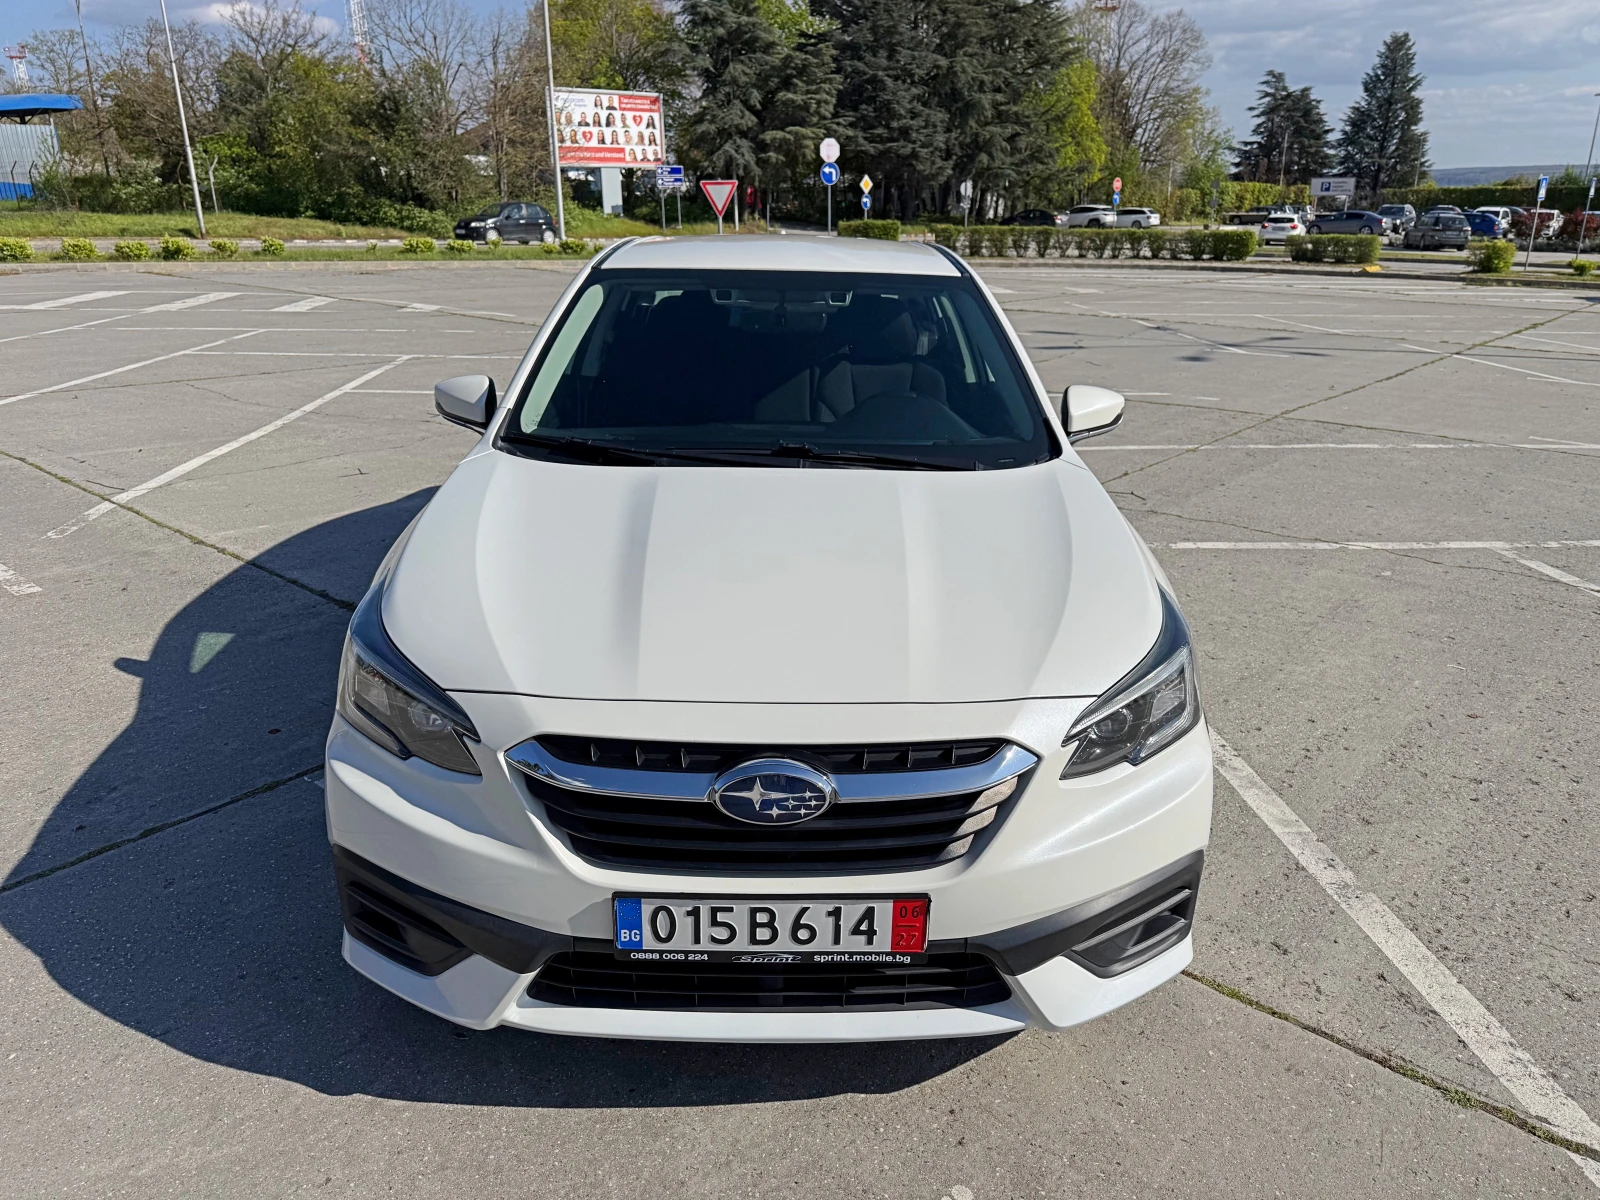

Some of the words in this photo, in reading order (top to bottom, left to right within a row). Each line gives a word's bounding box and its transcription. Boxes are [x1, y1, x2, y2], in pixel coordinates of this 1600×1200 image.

[899, 905, 920, 919] 06
[620, 929, 641, 942] BG
[895, 932, 919, 947] 27
[630, 952, 660, 960] 0888
[687, 953, 709, 961] 224
[739, 955, 796, 964] Sprint
[813, 953, 911, 963] sprint.mobile.bg
